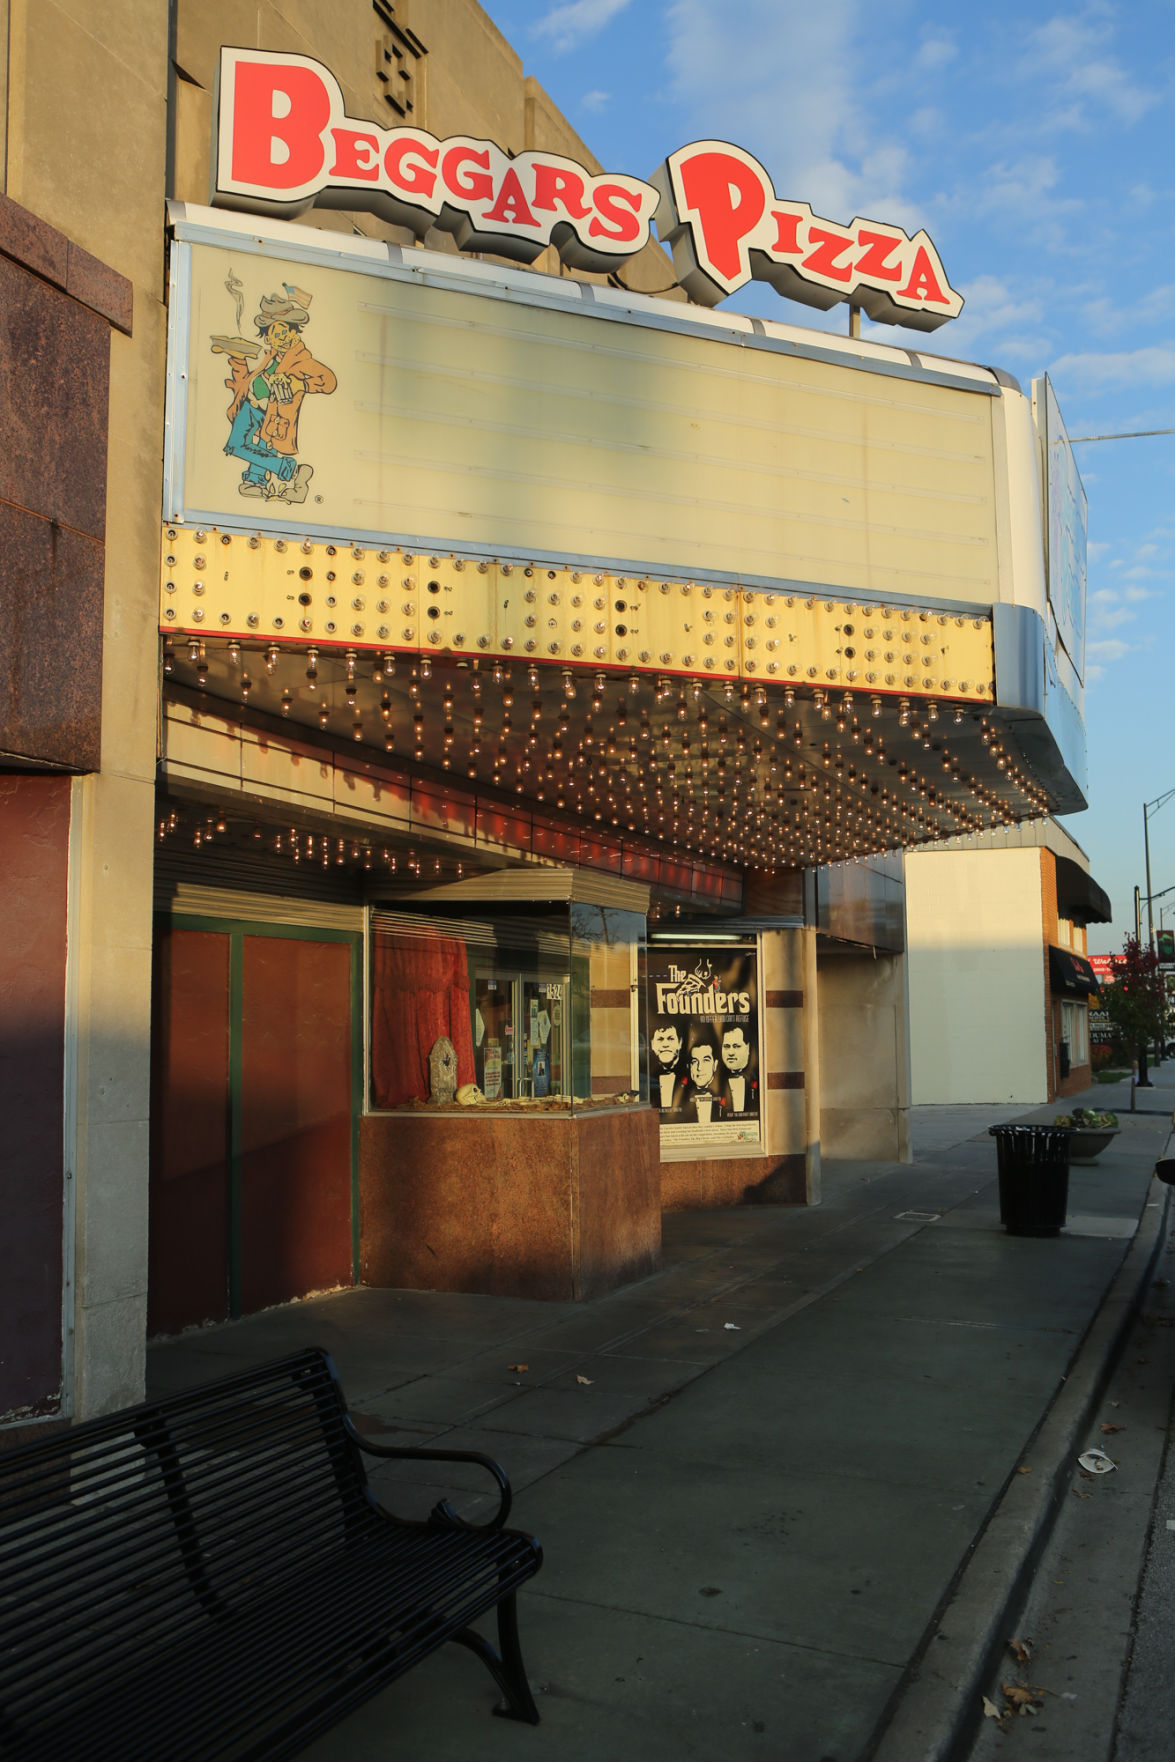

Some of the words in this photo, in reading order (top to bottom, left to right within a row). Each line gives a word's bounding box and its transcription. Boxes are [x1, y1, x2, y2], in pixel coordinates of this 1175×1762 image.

[230, 60, 643, 242] BEGGARS
[680, 152, 950, 305] PIZZA
[668, 965, 687, 983] The
[656, 983, 750, 1014] Founders
